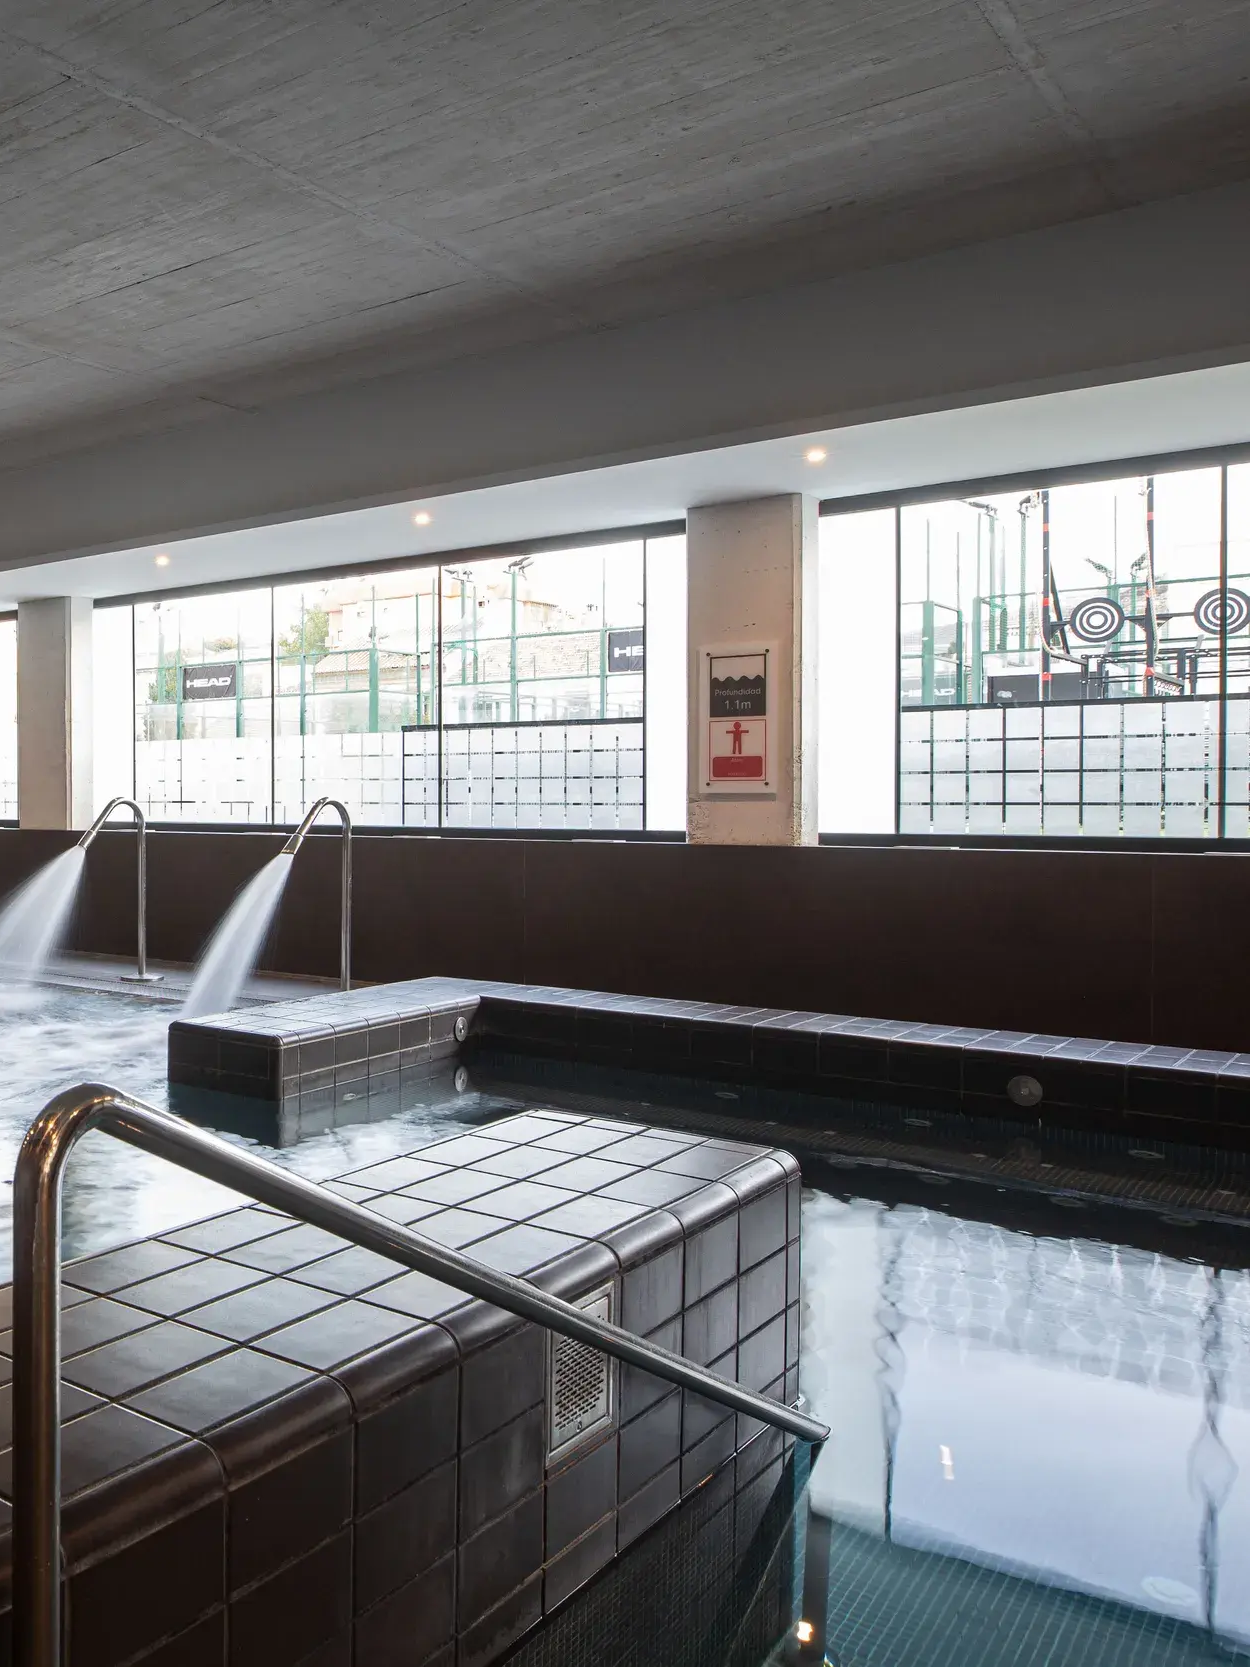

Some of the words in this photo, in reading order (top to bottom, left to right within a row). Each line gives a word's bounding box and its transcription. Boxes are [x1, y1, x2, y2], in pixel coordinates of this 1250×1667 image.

[186, 677, 231, 688] HEAD
[715, 688, 761, 696] Profundidad
[725, 700, 751, 710] 1.1m
